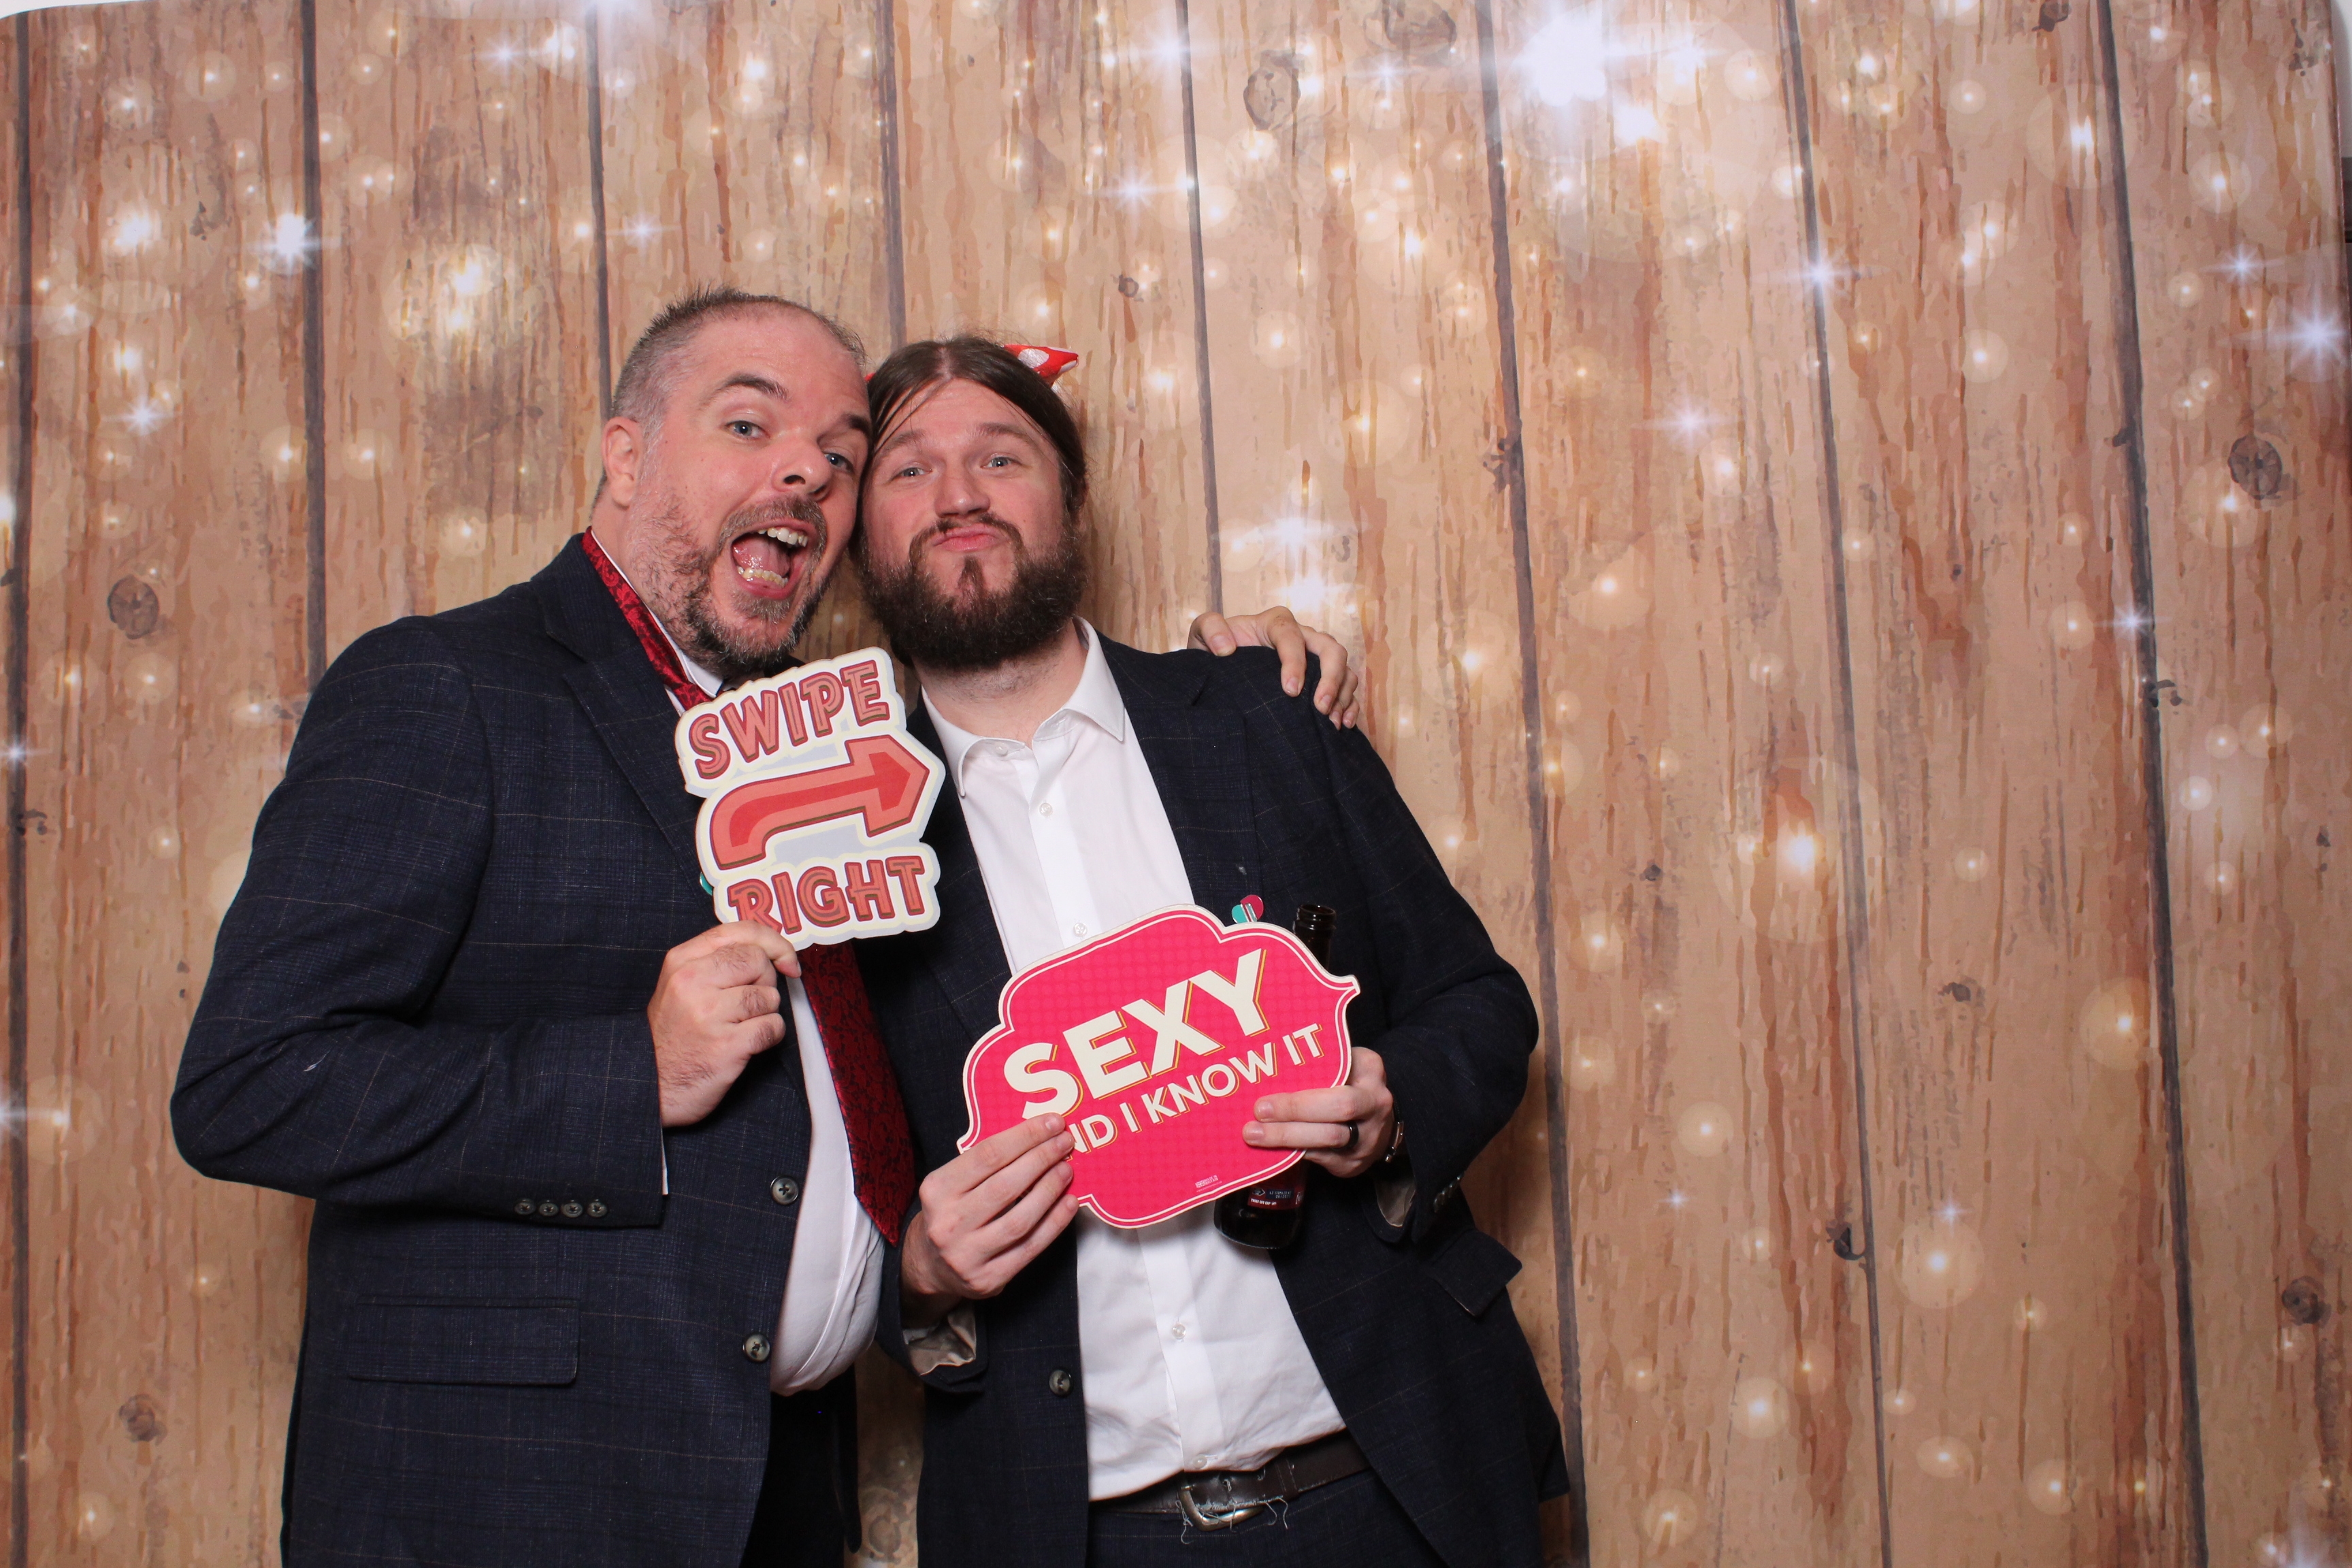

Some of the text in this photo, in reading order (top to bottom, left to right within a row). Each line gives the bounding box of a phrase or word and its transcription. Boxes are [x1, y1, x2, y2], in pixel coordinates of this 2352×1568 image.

[689, 659, 890, 780] SWIPE
[727, 855, 926, 934] RIGHT
[1003, 948, 1271, 1120] SEXY
[1063, 1022, 1324, 1161] ND I KNOW IT
